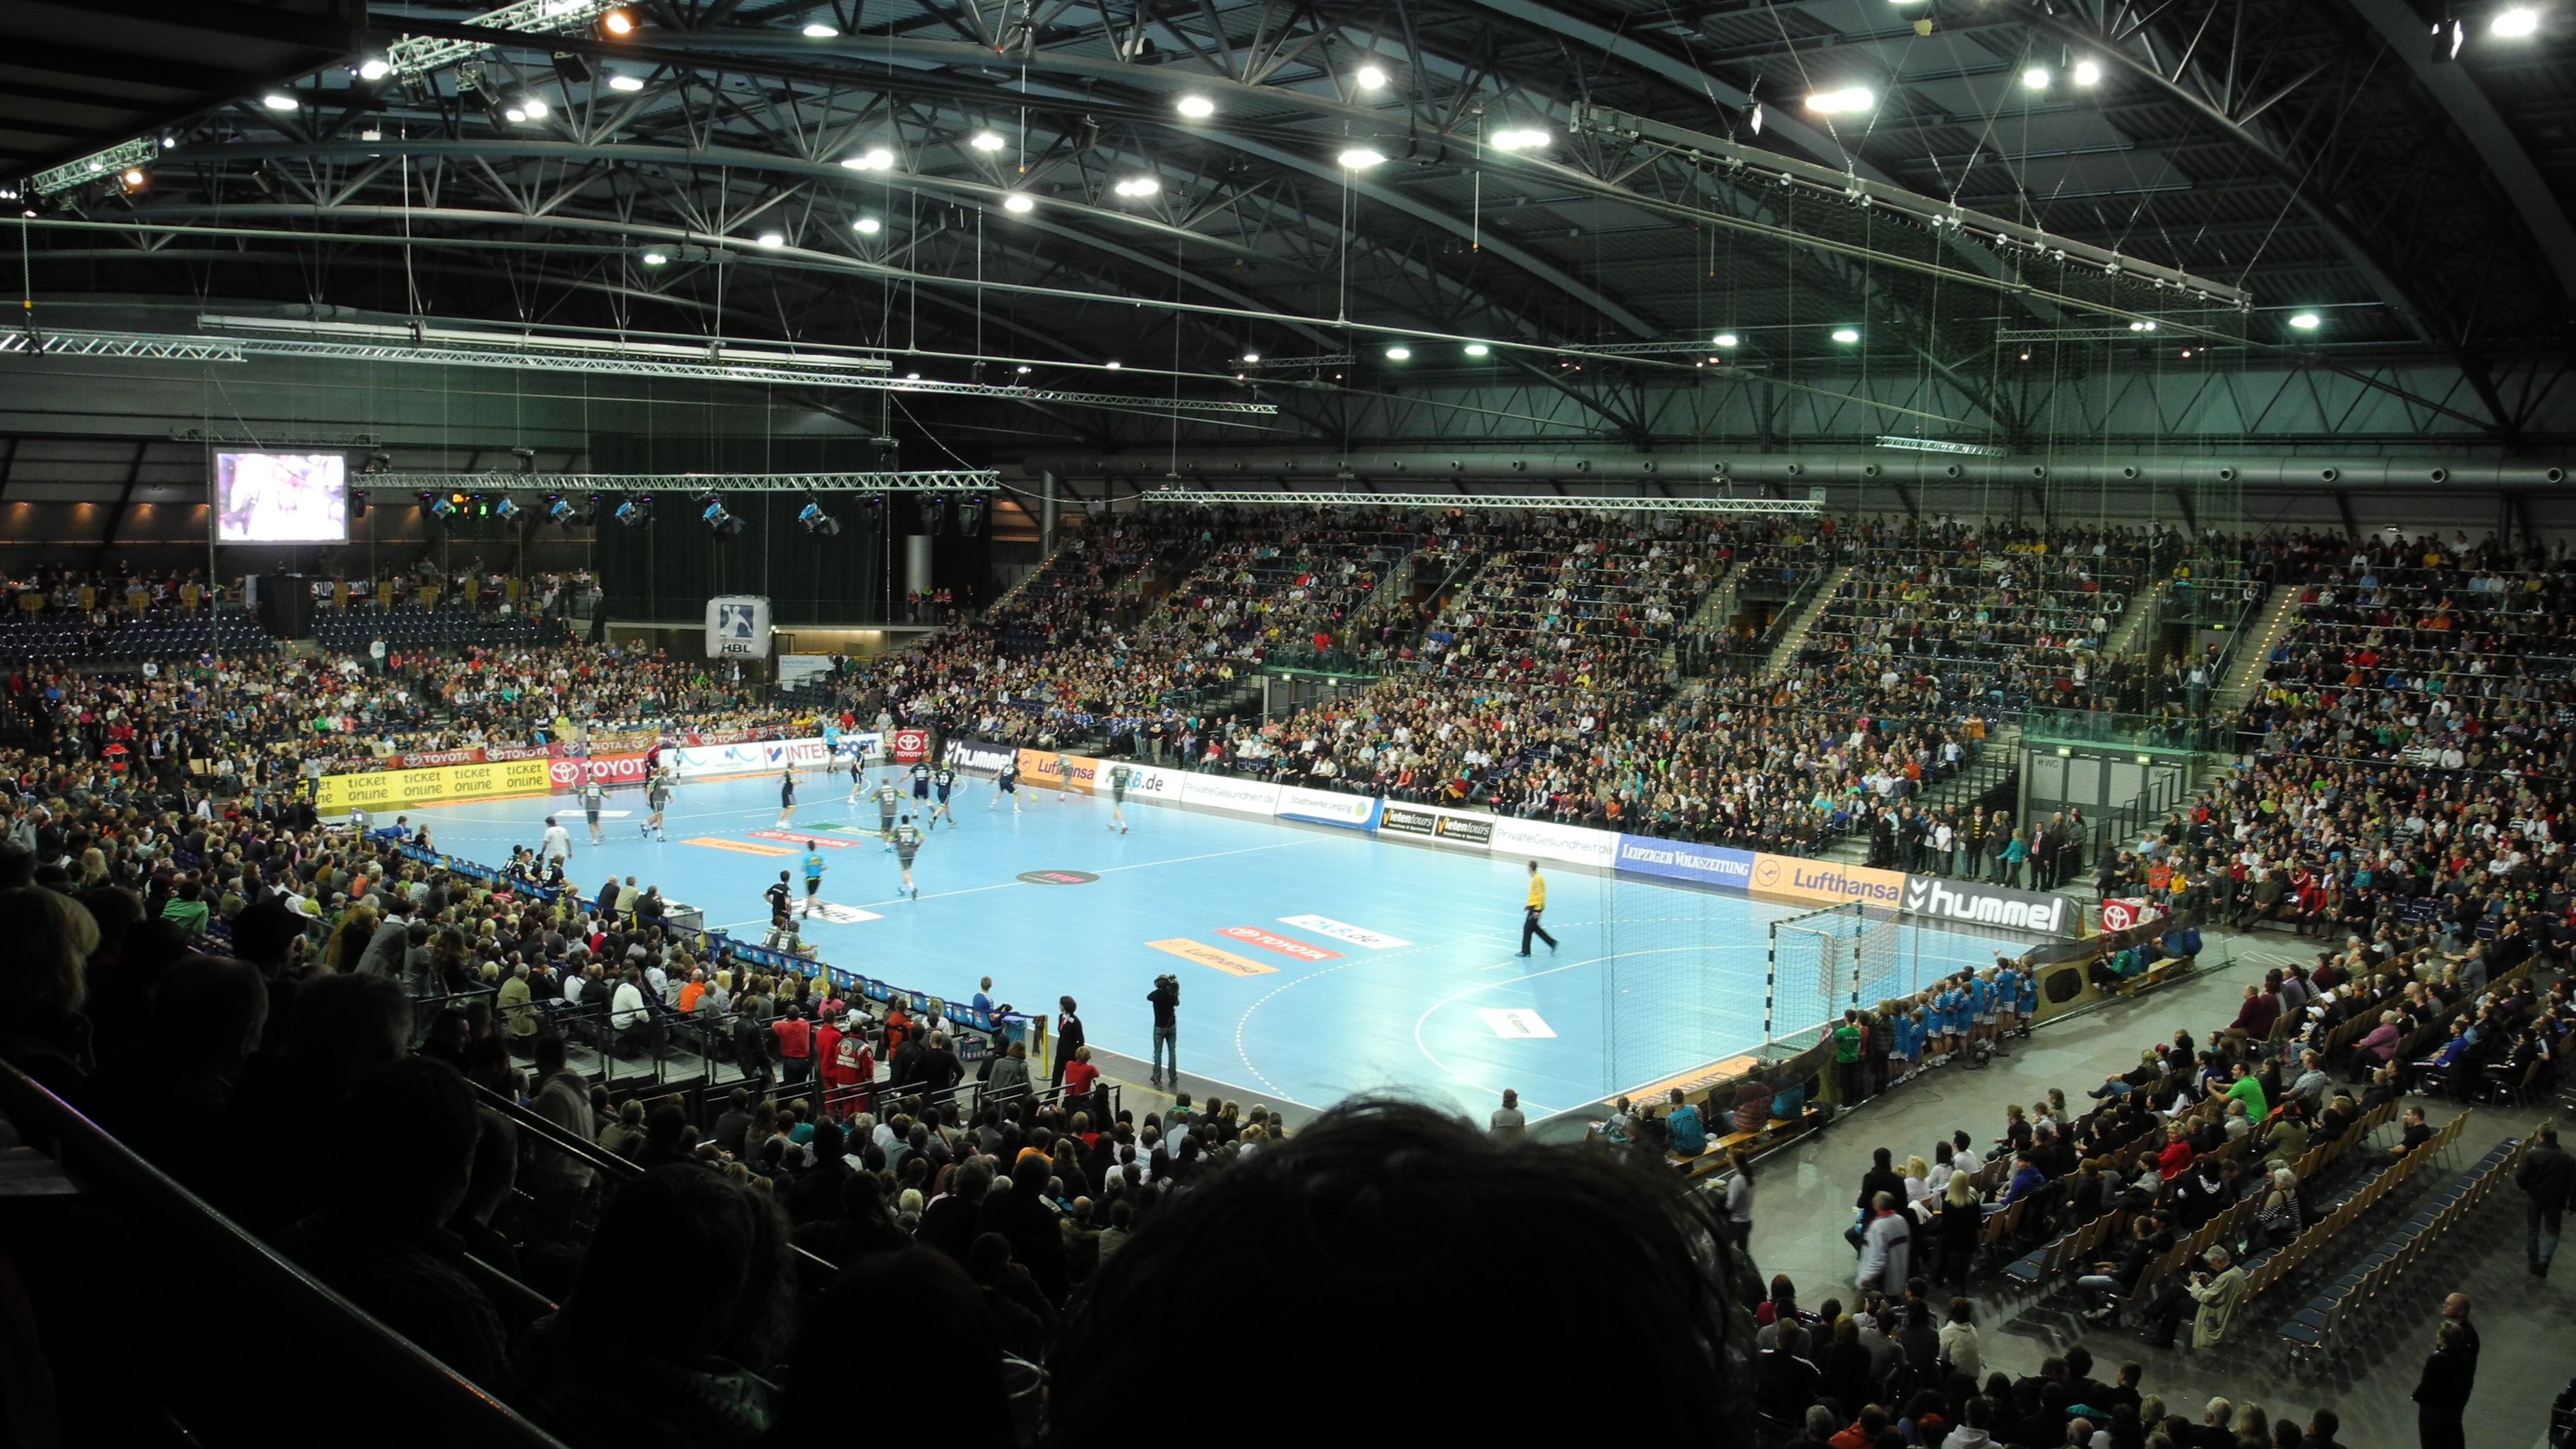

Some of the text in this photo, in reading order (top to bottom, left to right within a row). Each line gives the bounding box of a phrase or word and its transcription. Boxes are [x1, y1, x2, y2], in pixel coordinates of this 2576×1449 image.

[722, 643, 752, 653] HBL
[716, 733, 749, 744] TOYOTA
[423, 752, 471, 763] TOYOTA
[506, 747, 550, 759] TOYOTA
[953, 741, 1017, 770] hummel
[581, 758, 647, 777] TOYOT
[2044, 760, 2059, 768] WC
[1184, 782, 1275, 804] PrivateGesundheit.de
[1290, 795, 1352, 814] Stadtwerke Leipzig
[1496, 828, 1614, 855] PrivateGesundheit.de
[1621, 843, 1750, 876] LEIPZIGER VOLKSZEITUNG
[1793, 868, 1900, 902] Lufthansa
[1928, 881, 2063, 932] hummel
[1254, 935, 1329, 960] TOYOTA
[1185, 948, 1260, 974] Lufthansa
[1673, 1115, 1693, 1126] FOTO
